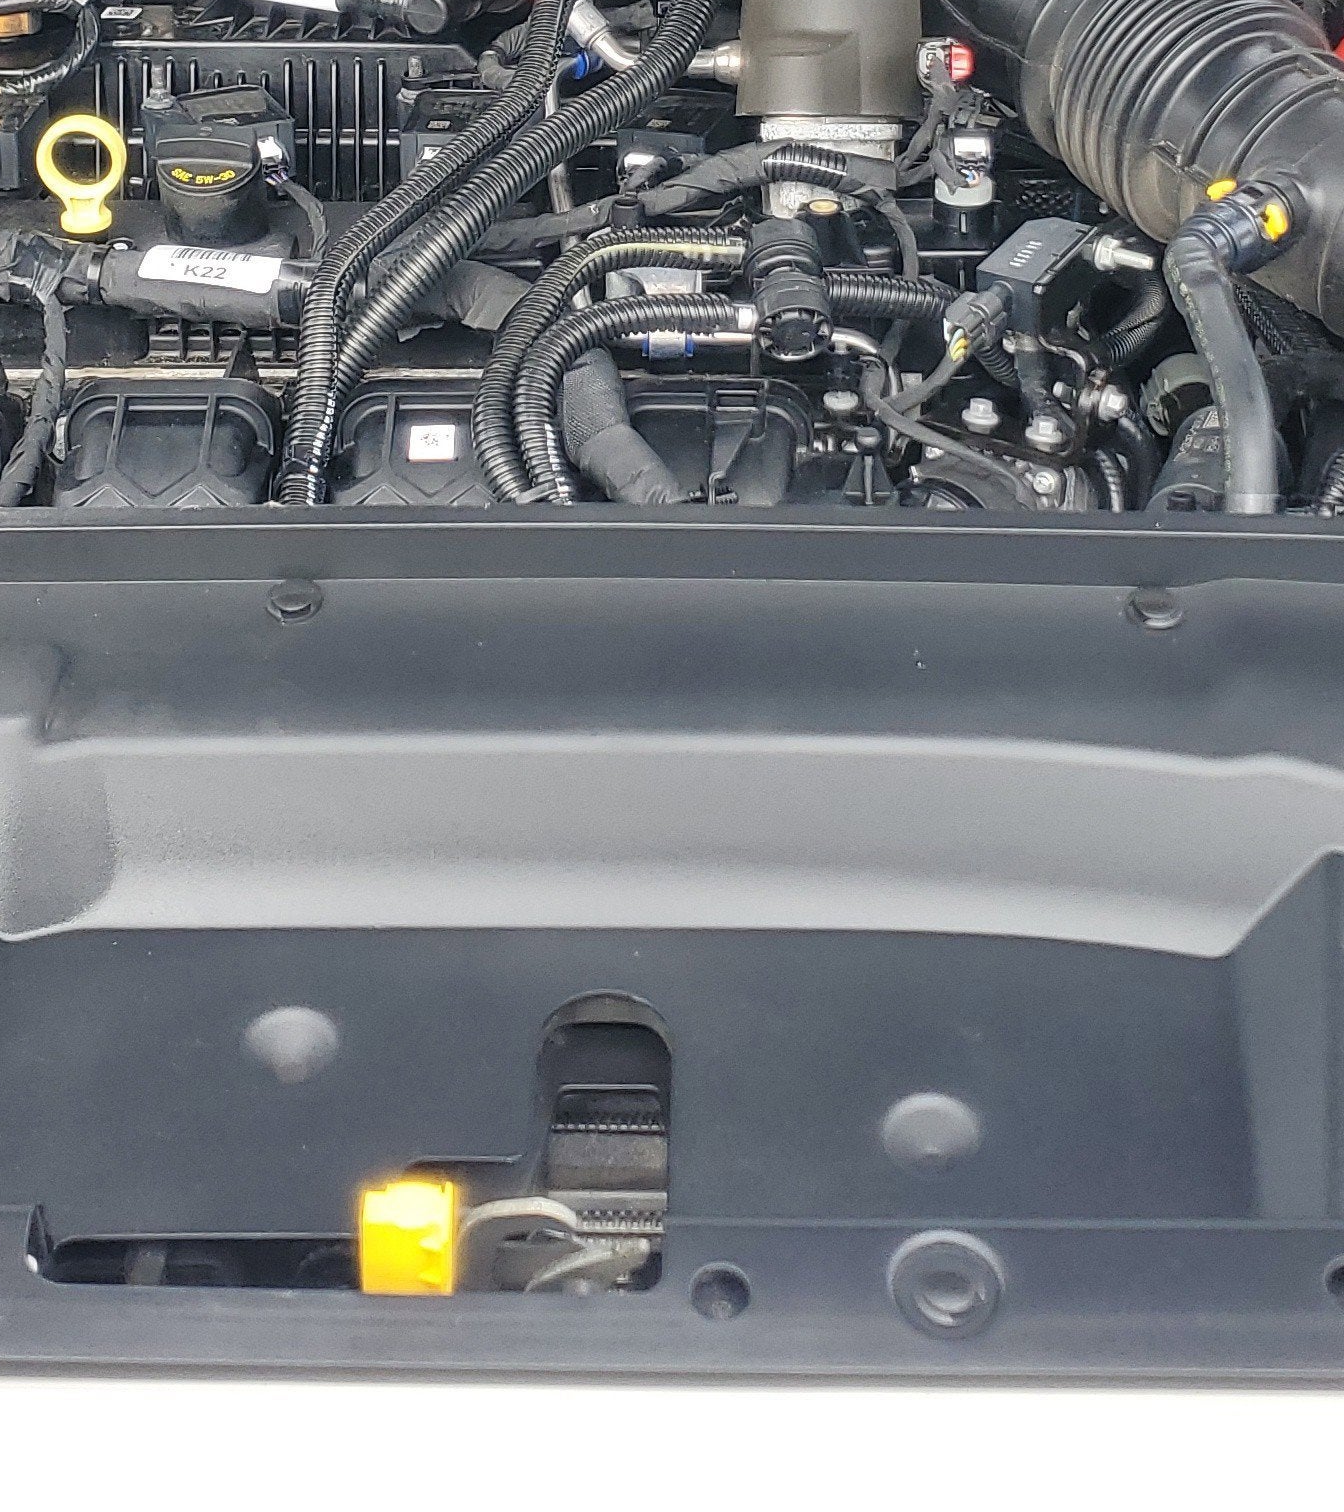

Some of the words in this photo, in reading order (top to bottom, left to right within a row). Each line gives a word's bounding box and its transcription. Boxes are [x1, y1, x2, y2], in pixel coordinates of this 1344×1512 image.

[171, 168, 193, 183] SAE
[195, 169, 236, 185] 5W-30
[183, 264, 227, 280] K22
